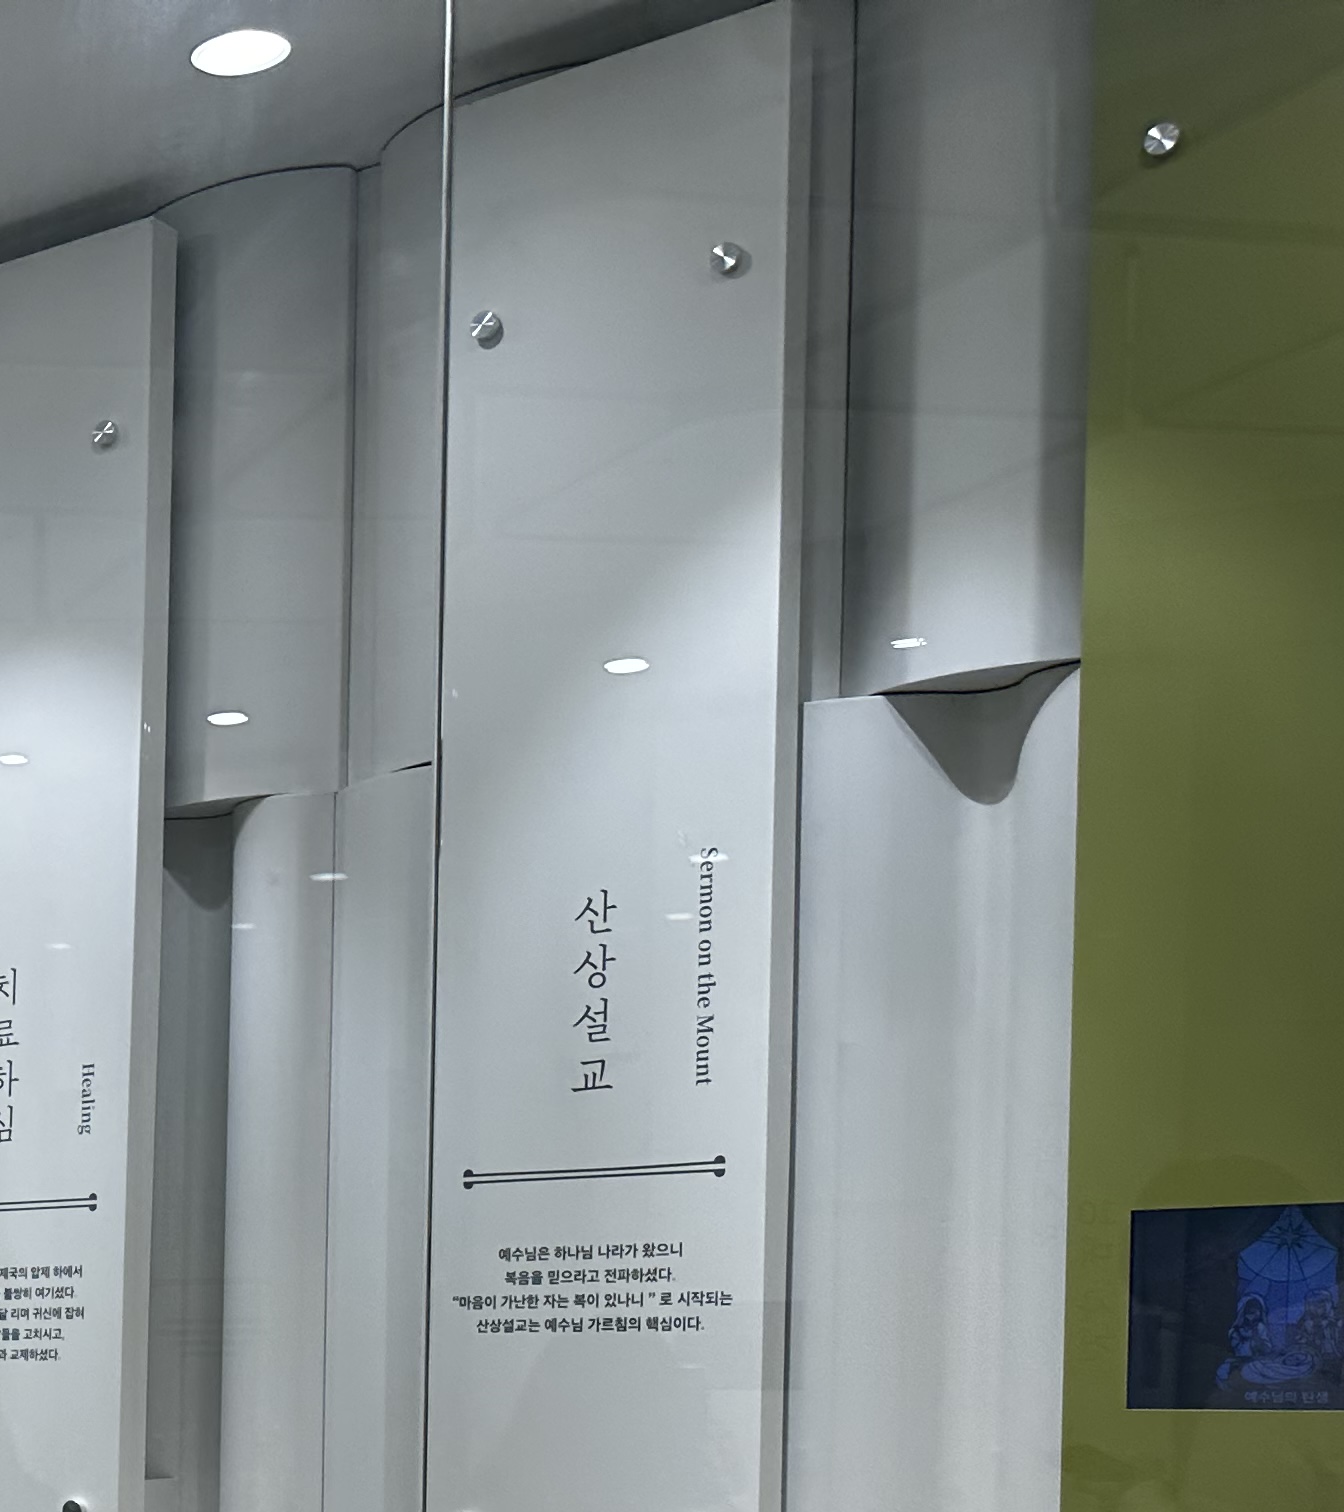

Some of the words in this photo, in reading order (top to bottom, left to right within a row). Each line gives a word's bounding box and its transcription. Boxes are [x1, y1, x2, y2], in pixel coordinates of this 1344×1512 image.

[698, 847, 719, 933] Sermon
[698, 939, 714, 966] on
[571, 888, 618, 1093] 산상설교
[697, 972, 718, 1009] the
[694, 1015, 715, 1087] Mount
[77, 1063, 96, 1136] Healing
[499, 1247, 550, 1262] 예수님은
[554, 1245, 592, 1260] 하나님
[598, 1244, 638, 1259] 나라가
[642, 1242, 683, 1258] 왔으니
[53, 1265, 82, 1278] 하에서
[505, 1271, 543, 1285] 복음을
[548, 1269, 599, 1284] 믿으라고
[4, 1288, 32, 1300] 불쌍히
[501, 1294, 539, 1309] 가난한
[543, 1294, 569, 1308] 자는
[574, 1293, 599, 1308] 복이
[659, 1293, 673, 1305] 로
[678, 1291, 733, 1306] 시작되는
[33, 1308, 61, 1319] 귀신에
[477, 1319, 540, 1333] 산상설교는
[545, 1318, 583, 1333] 예수님
[588, 1317, 641, 1332] 가르침의
[646, 1317, 704, 1331] 핵심이다.
